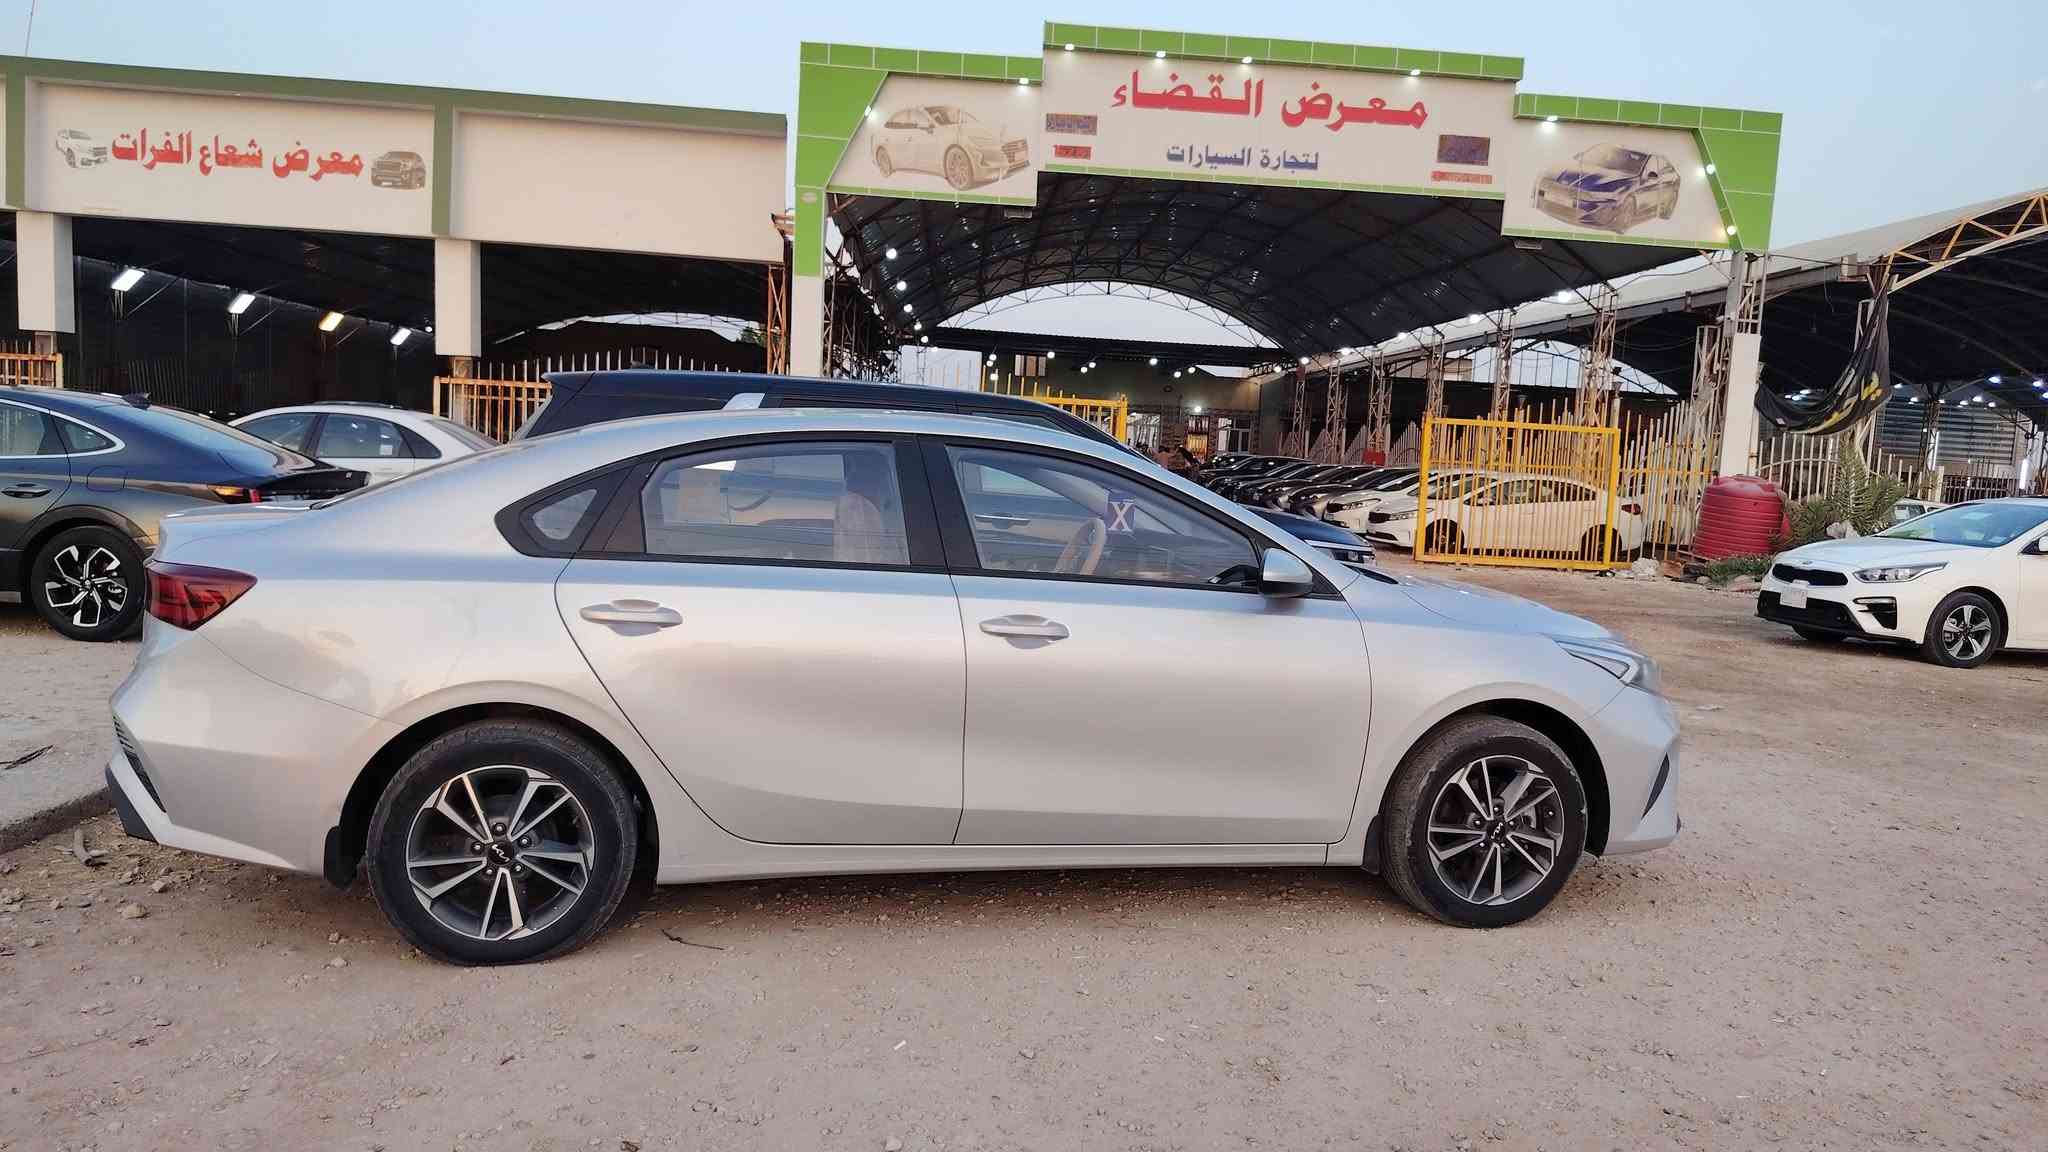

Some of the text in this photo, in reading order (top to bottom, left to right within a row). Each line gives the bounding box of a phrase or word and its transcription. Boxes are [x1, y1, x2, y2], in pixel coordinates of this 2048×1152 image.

[1111, 70, 1429, 132] معرض القضاء
[111, 128, 364, 182] معرض شعاع الفرات
[1166, 144, 1320, 173] لتجارة السيارات
